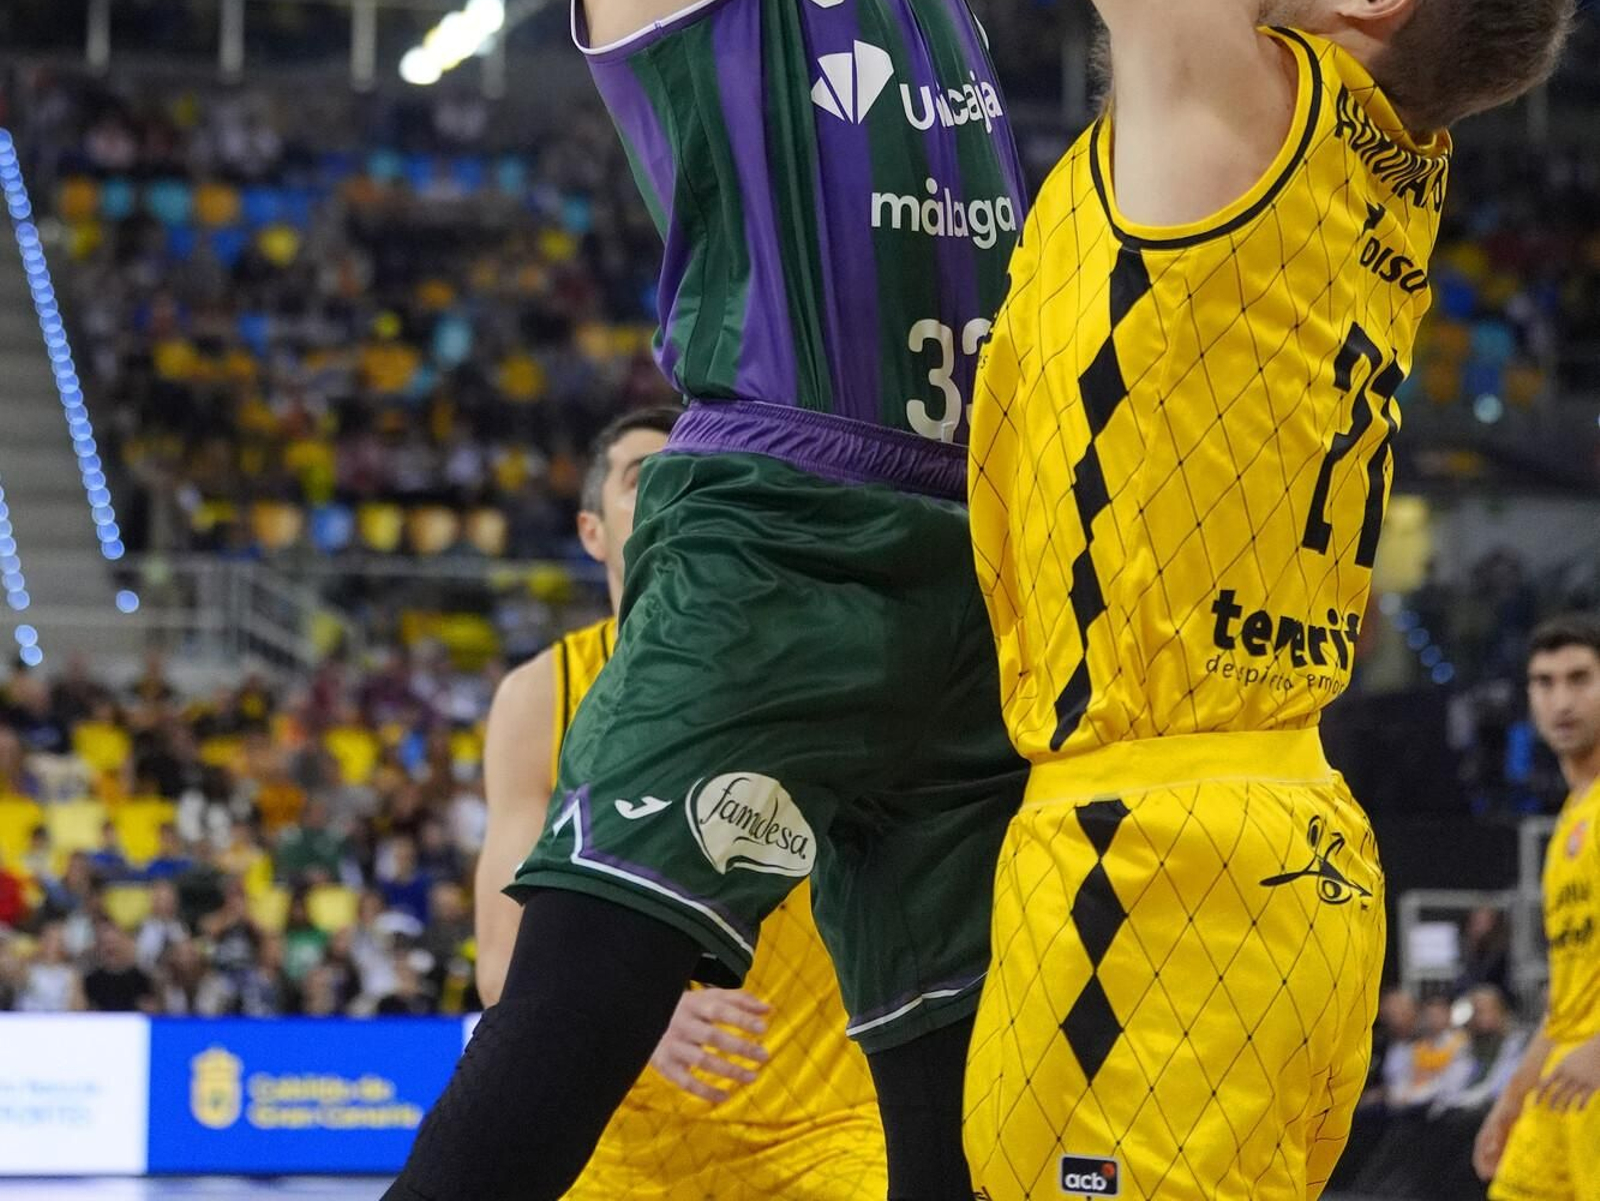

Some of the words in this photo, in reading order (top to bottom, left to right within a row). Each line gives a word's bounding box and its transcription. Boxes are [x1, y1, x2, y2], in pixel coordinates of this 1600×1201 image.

[900, 70, 1003, 134] Unicaja
[1301, 320, 1405, 569] 21
[1065, 1172, 1107, 1191] acb
